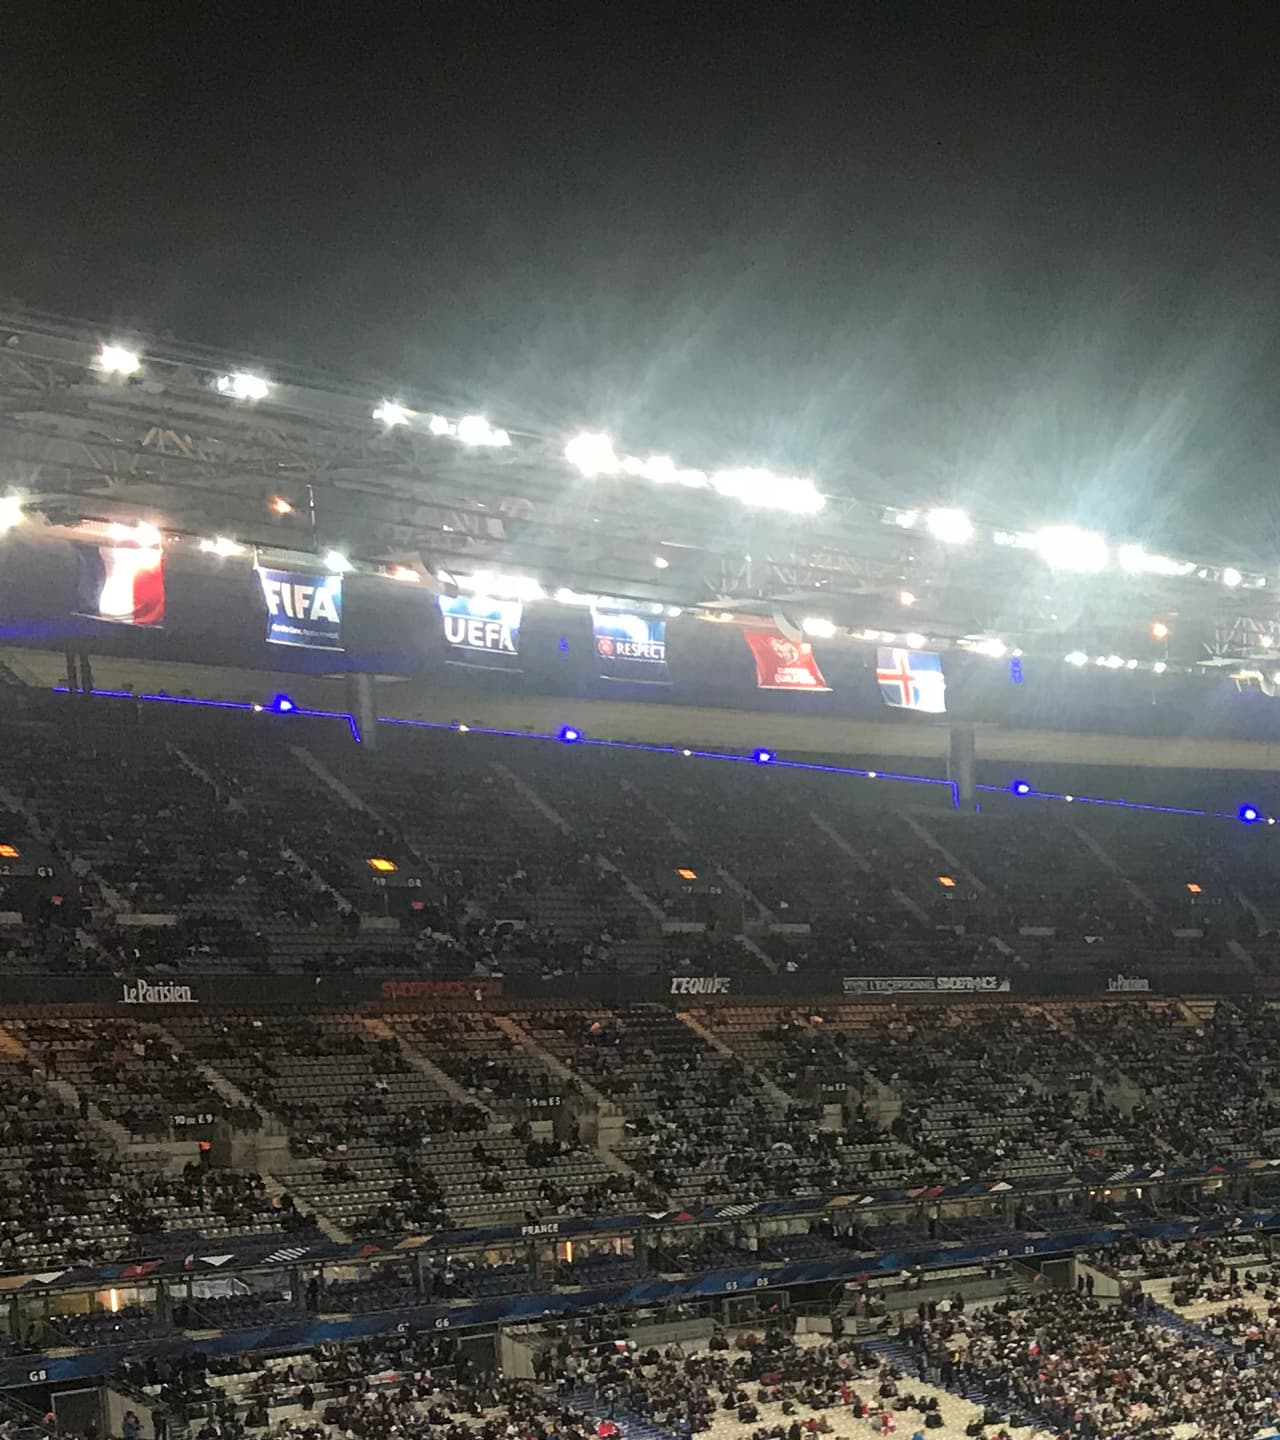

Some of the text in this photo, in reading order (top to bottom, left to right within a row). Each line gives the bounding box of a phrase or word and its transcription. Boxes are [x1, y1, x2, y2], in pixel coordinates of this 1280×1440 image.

[262, 580, 340, 623] FIFA
[444, 617, 515, 651] UEFA
[616, 643, 666, 659] RESPECT
[123, 979, 191, 1003] Le Parisien
